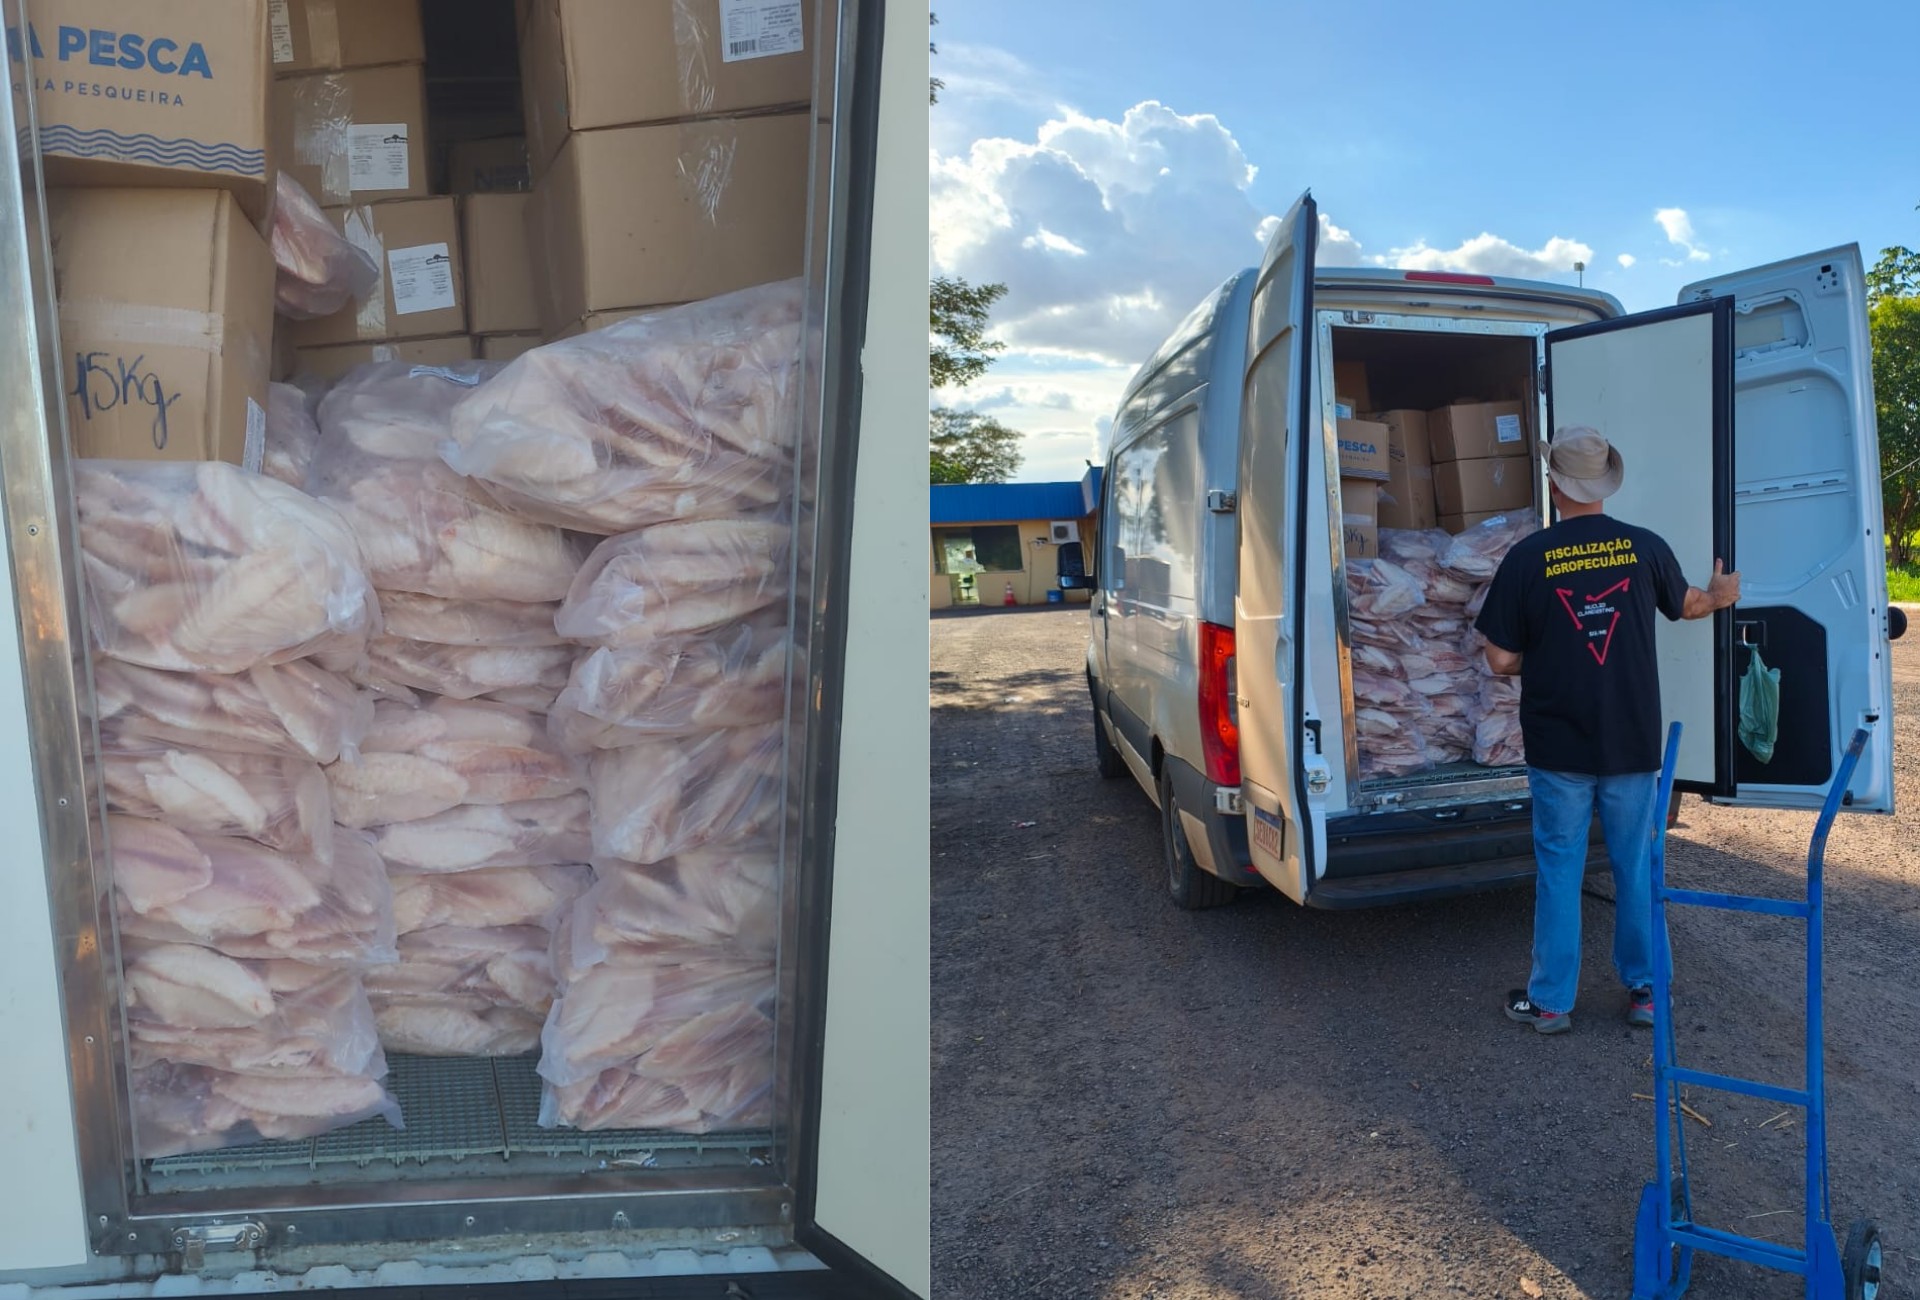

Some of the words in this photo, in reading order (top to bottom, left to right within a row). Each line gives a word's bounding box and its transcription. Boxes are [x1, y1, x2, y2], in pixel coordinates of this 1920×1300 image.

[58, 25, 213, 79] PESCA
[64, 80, 184, 107] PESQUEIRA
[1338, 439, 1377, 454] PESCA
[1544, 538, 1632, 562] FISCALIZAÇÃO
[1545, 552, 1638, 577] AGROPECUÁRIA
[1513, 1001, 1530, 1010] FILA
